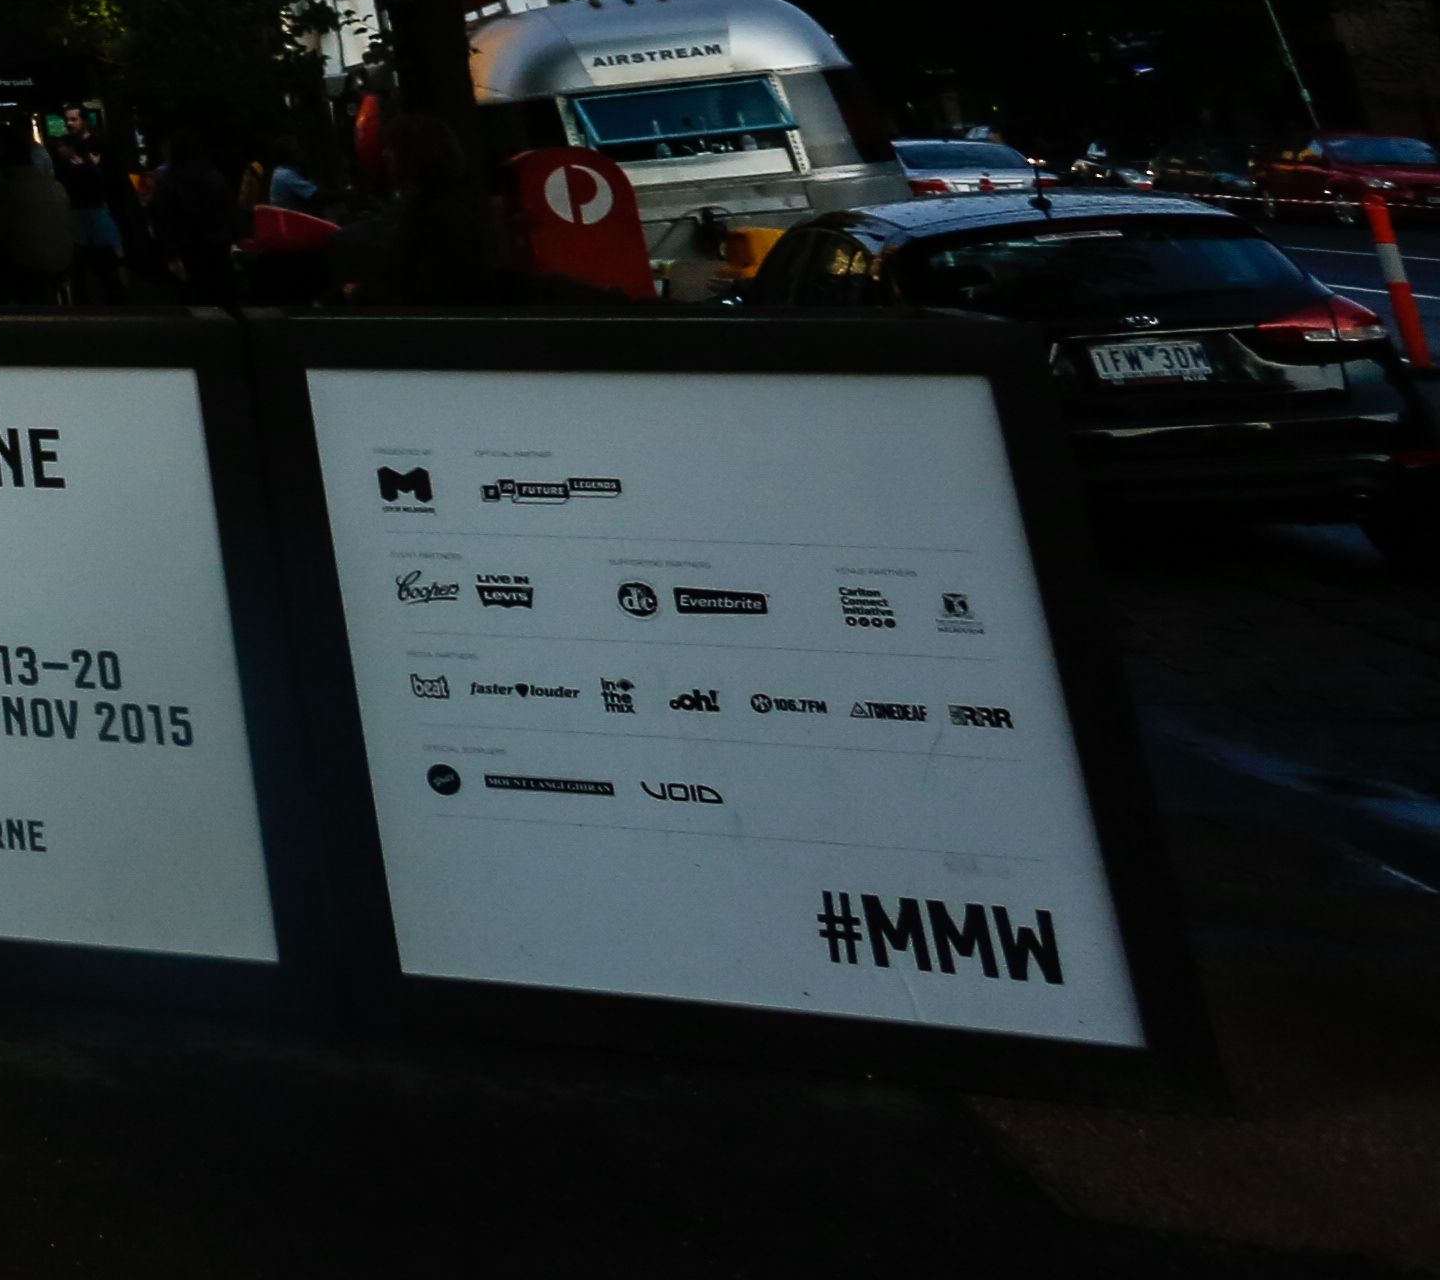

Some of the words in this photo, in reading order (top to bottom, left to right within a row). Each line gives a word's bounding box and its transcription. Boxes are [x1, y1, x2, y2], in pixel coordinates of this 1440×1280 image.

[593, 44, 722, 67] AIRSTREAM
[521, 486, 565, 496] FUTURE
[573, 480, 617, 489] LEGENDS
[396, 570, 461, 604] Coopers
[839, 587, 882, 597] Carlton
[680, 594, 763, 611] Eventbrite
[841, 597, 889, 607] Connect
[843, 606, 894, 617] Initiative
[412, 674, 450, 699] beat
[470, 681, 514, 697] faster
[602, 690, 633, 703] the
[605, 703, 637, 714] mix
[2, 696, 79, 739] NOV
[96, 704, 194, 747] 2015
[640, 780, 724, 804] VOID
[818, 891, 1064, 985] #MMW
